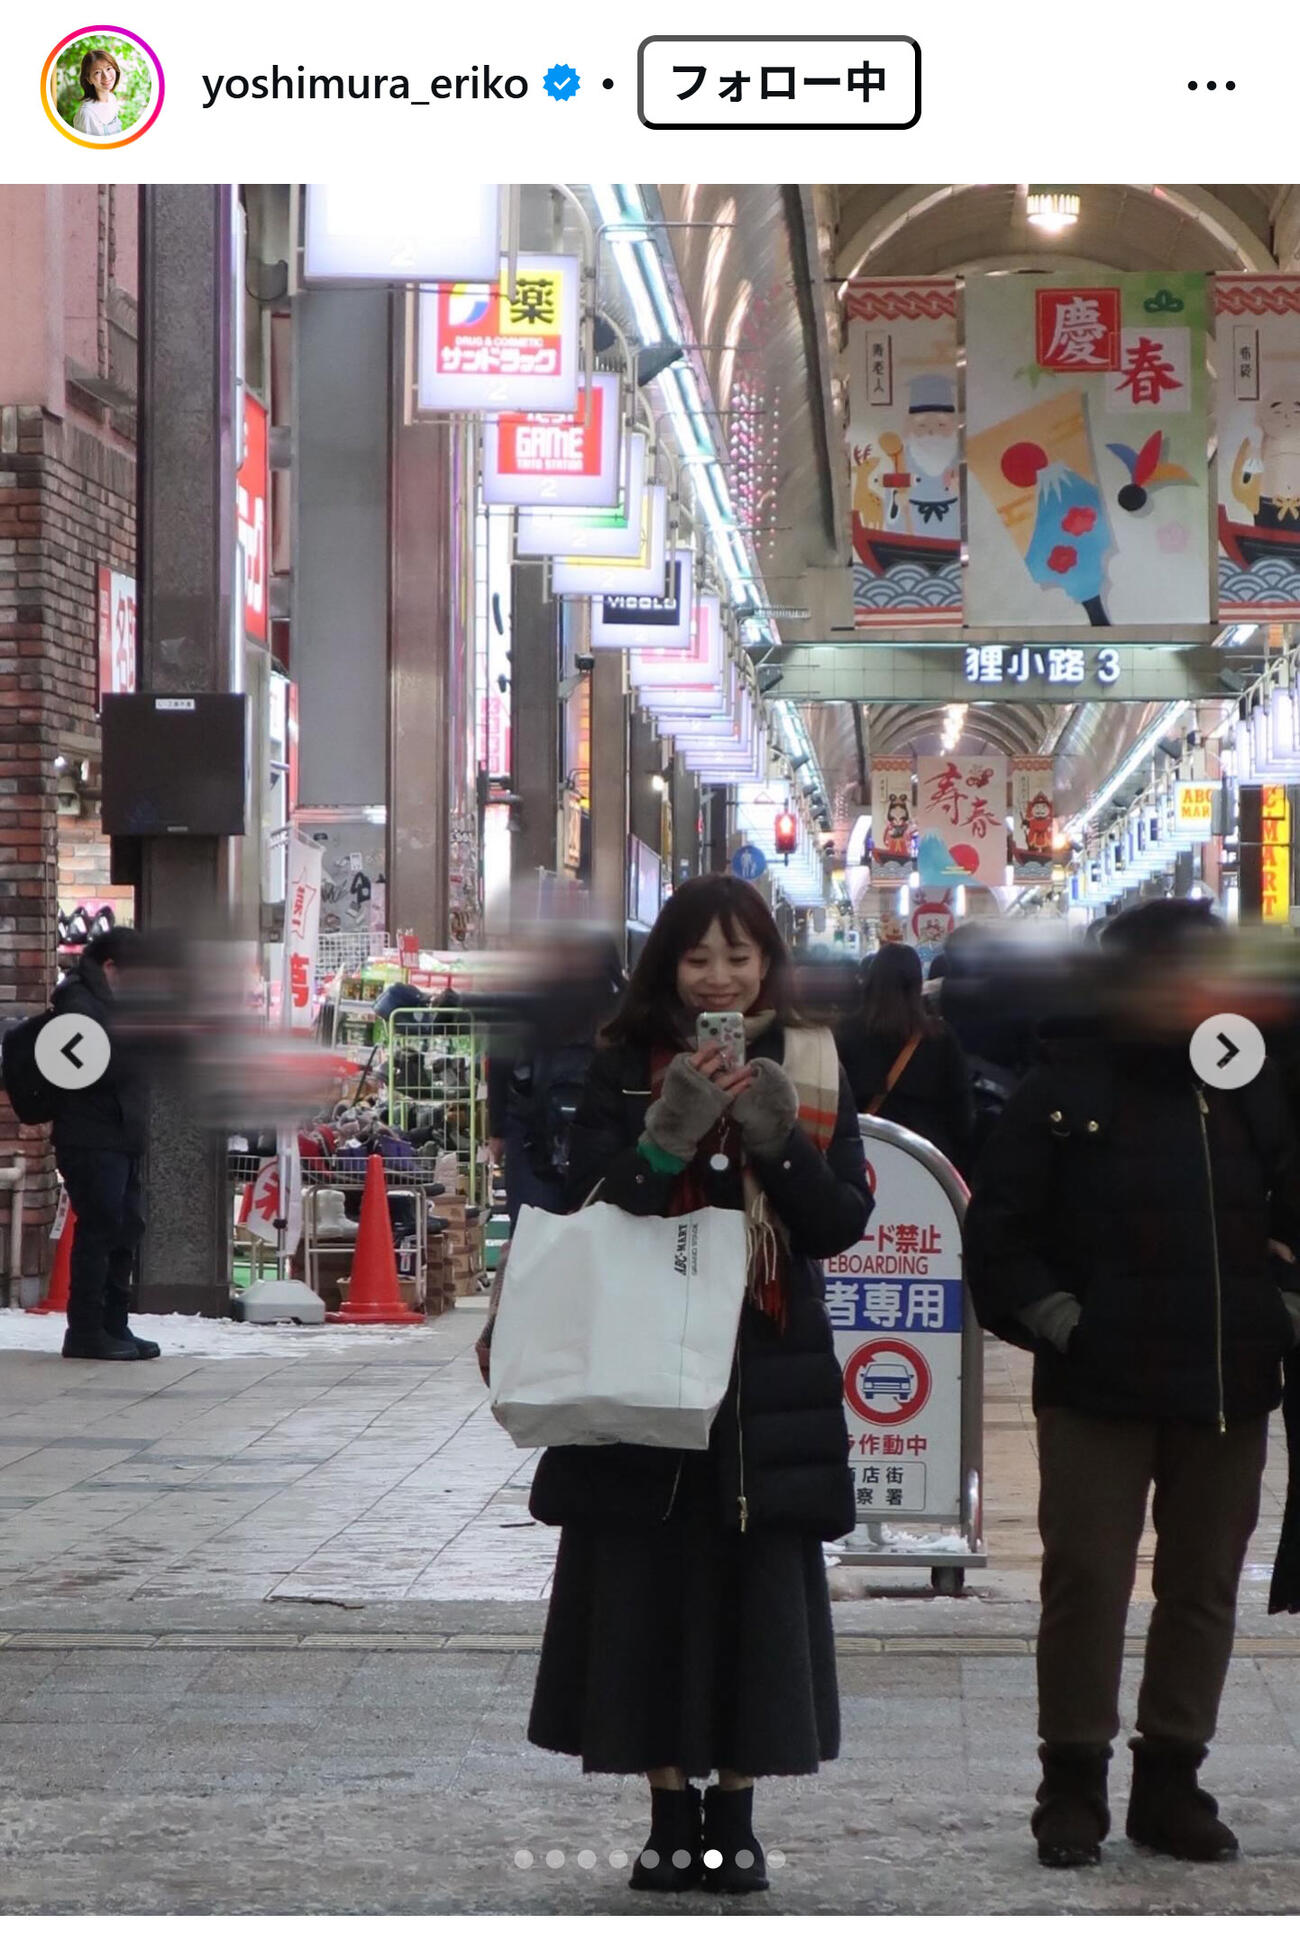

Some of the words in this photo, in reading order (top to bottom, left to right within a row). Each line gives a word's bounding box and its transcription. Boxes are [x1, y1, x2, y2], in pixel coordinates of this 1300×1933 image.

[510, 278, 554, 324] 薬
[516, 427, 584, 459] GAME
[540, 478, 558, 497] 2
[965, 646, 1086, 683] 狸小路
[1097, 648, 1121, 683] 3
[824, 1281, 945, 1328] 者専用
